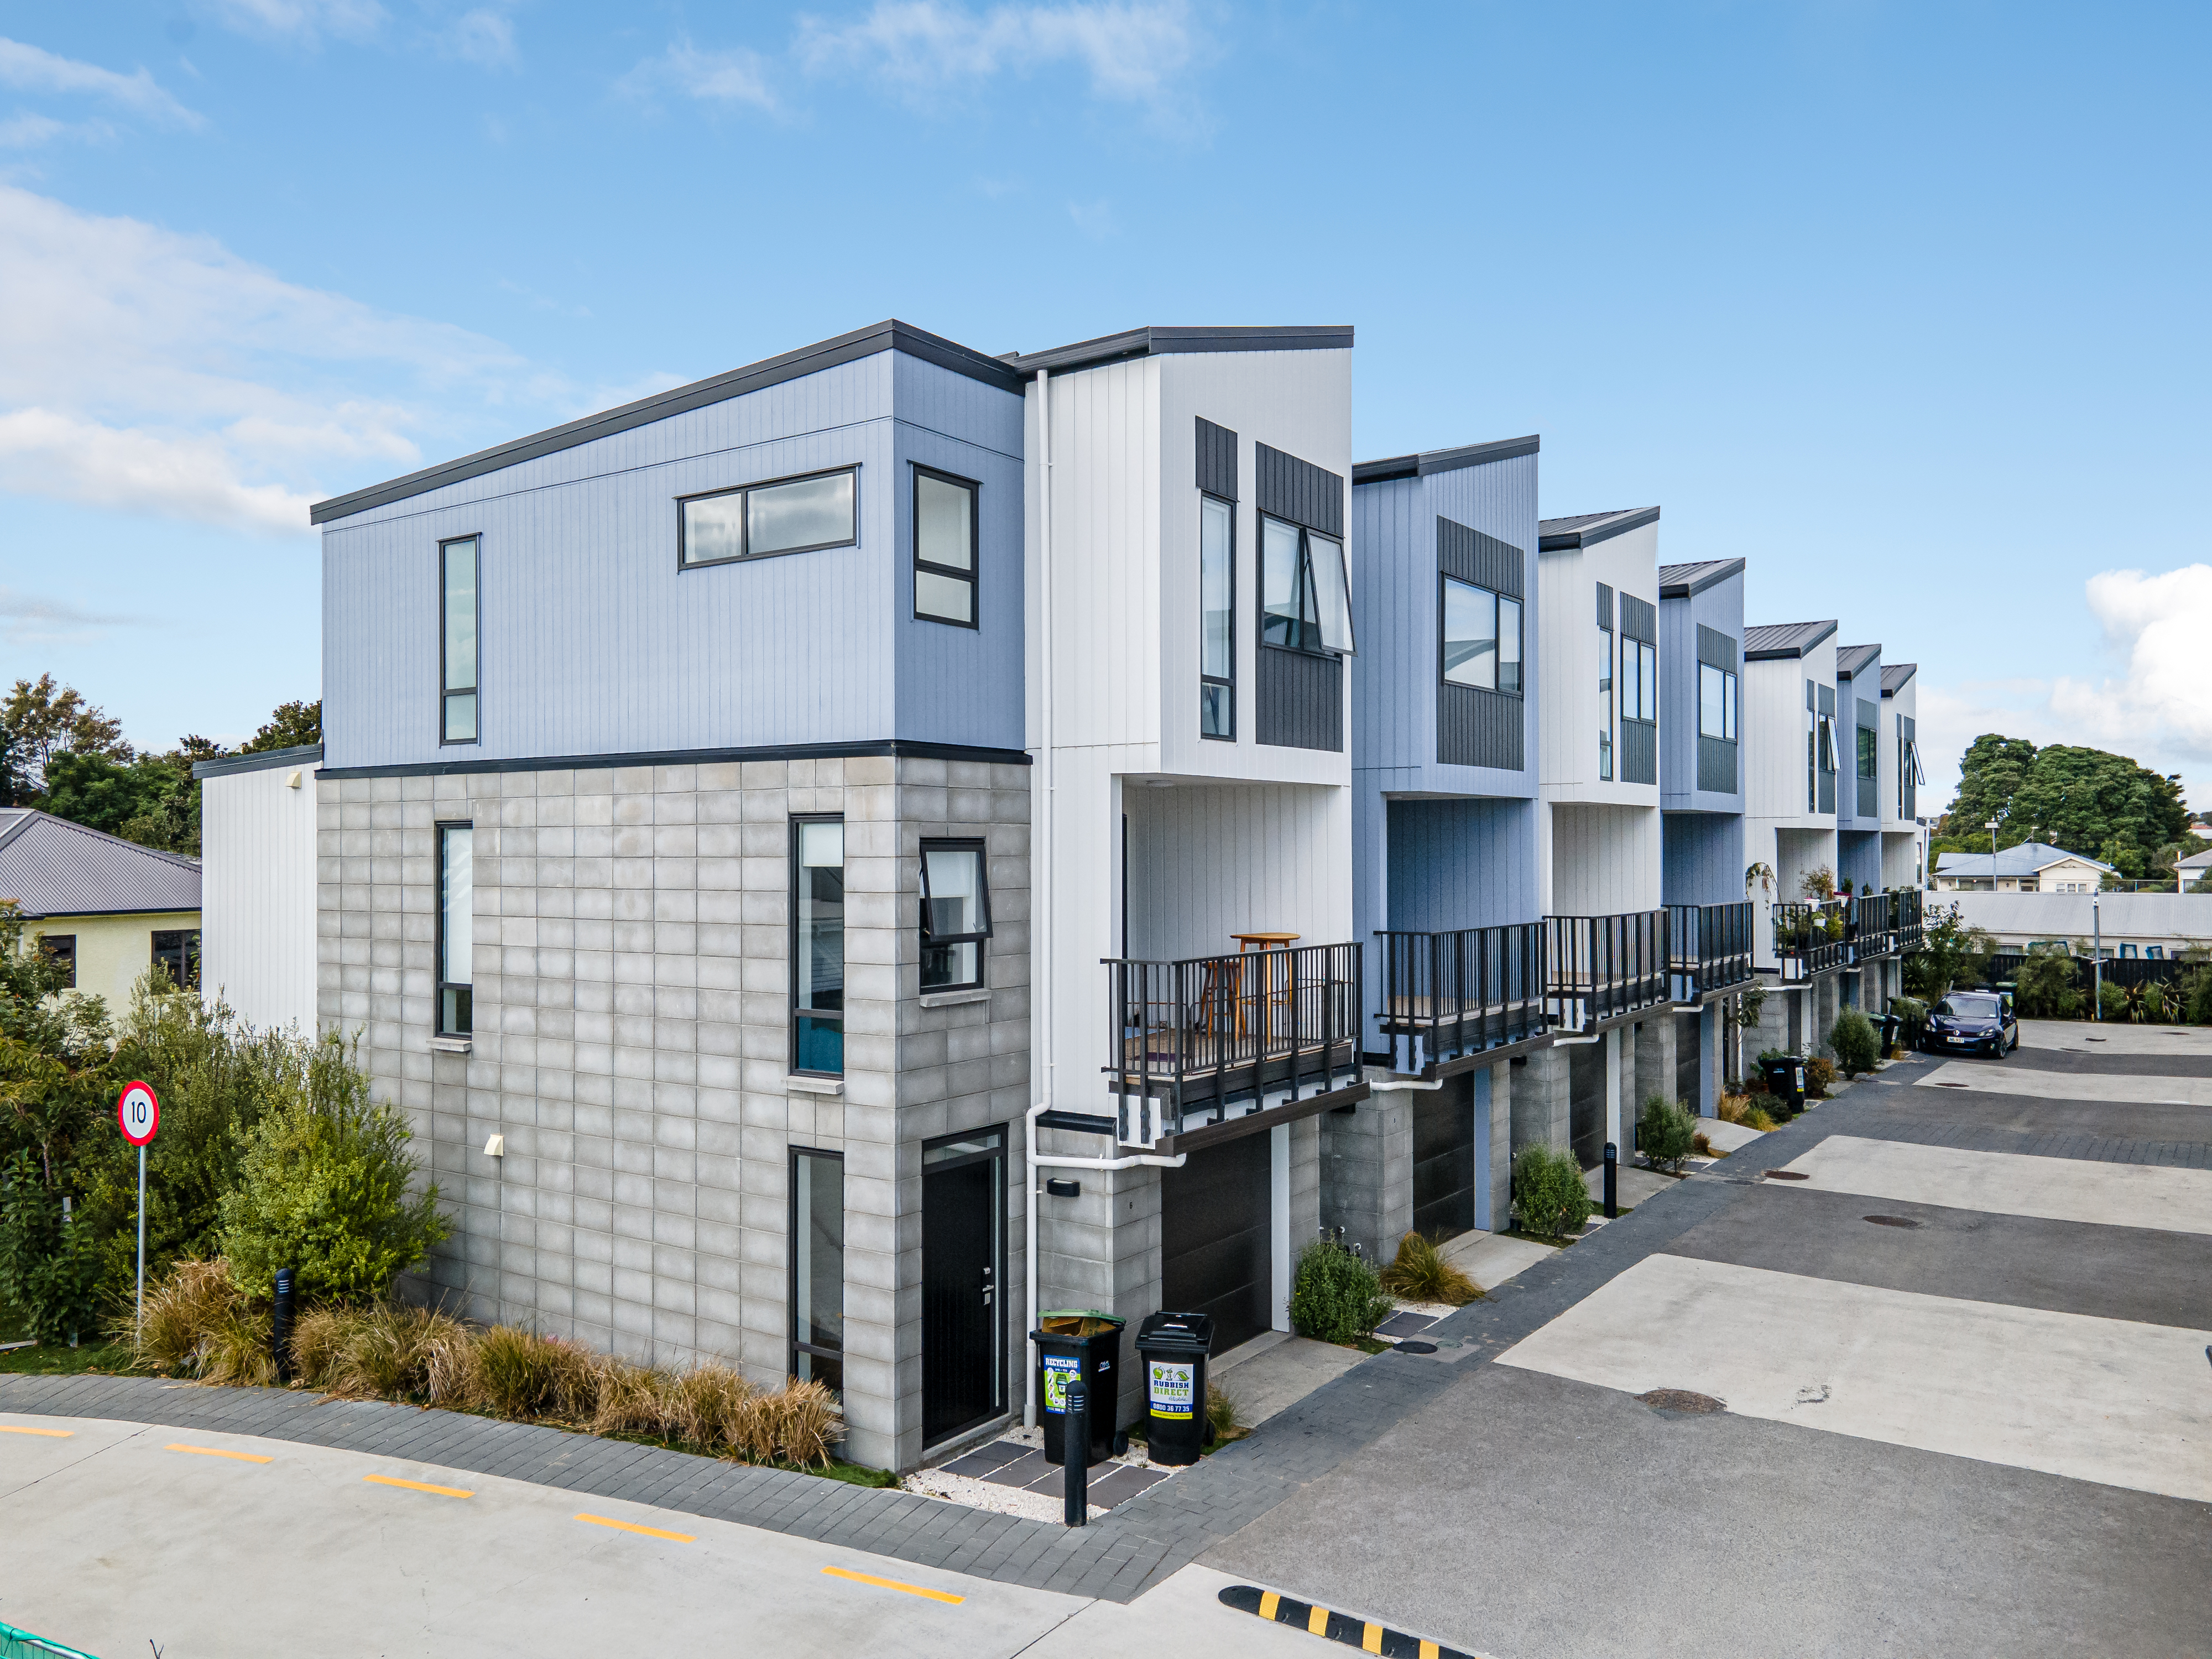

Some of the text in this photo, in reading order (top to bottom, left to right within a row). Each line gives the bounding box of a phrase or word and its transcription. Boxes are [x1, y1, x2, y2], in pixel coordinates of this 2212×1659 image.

[131, 1101, 147, 1124] 10
[1045, 1357, 1078, 1368] RECYCLING
[1154, 1380, 1189, 1389] RUBBISH
[1154, 1386, 1189, 1396] DIRECT
